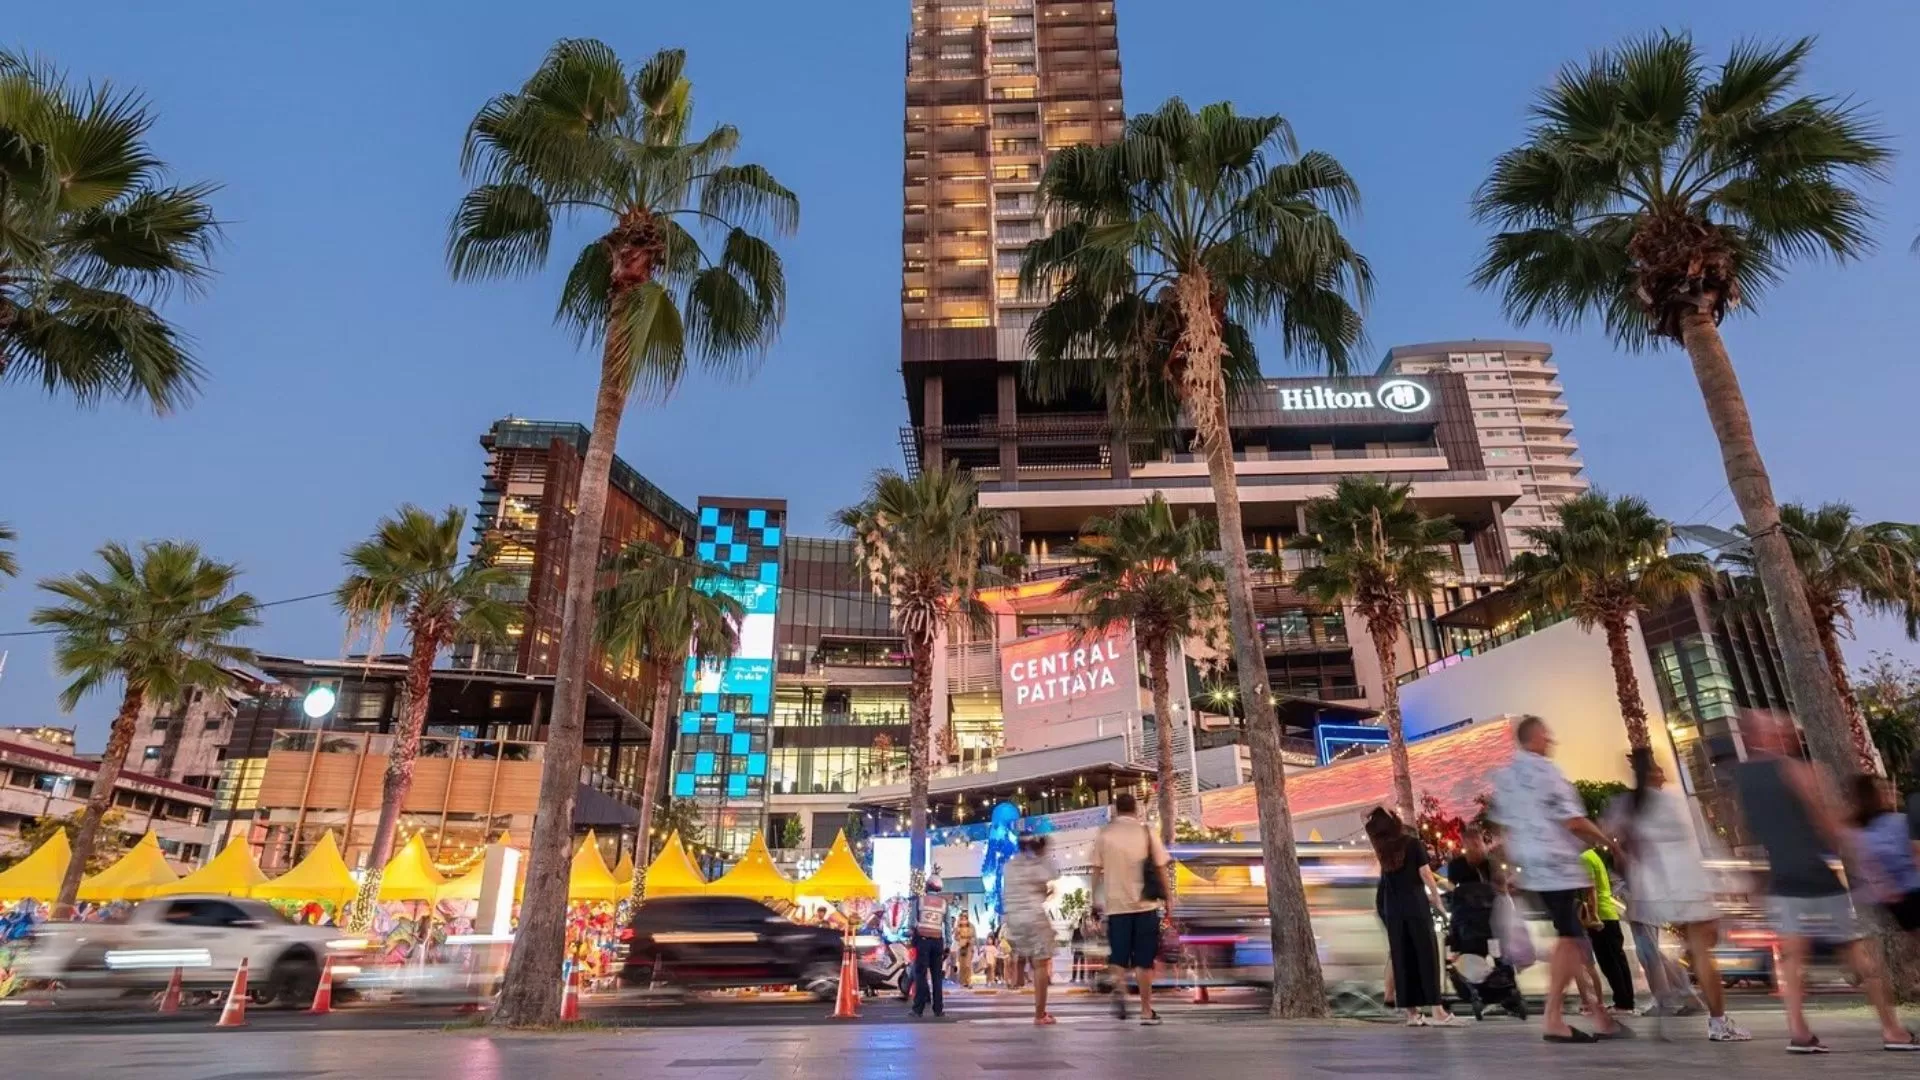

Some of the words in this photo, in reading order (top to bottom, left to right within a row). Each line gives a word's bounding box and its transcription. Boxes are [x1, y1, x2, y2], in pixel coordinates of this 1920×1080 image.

[1280, 386, 1374, 410] Hilton
[1010, 640, 1120, 682] CENTRAL
[1016, 666, 1116, 705] PATTAYA
